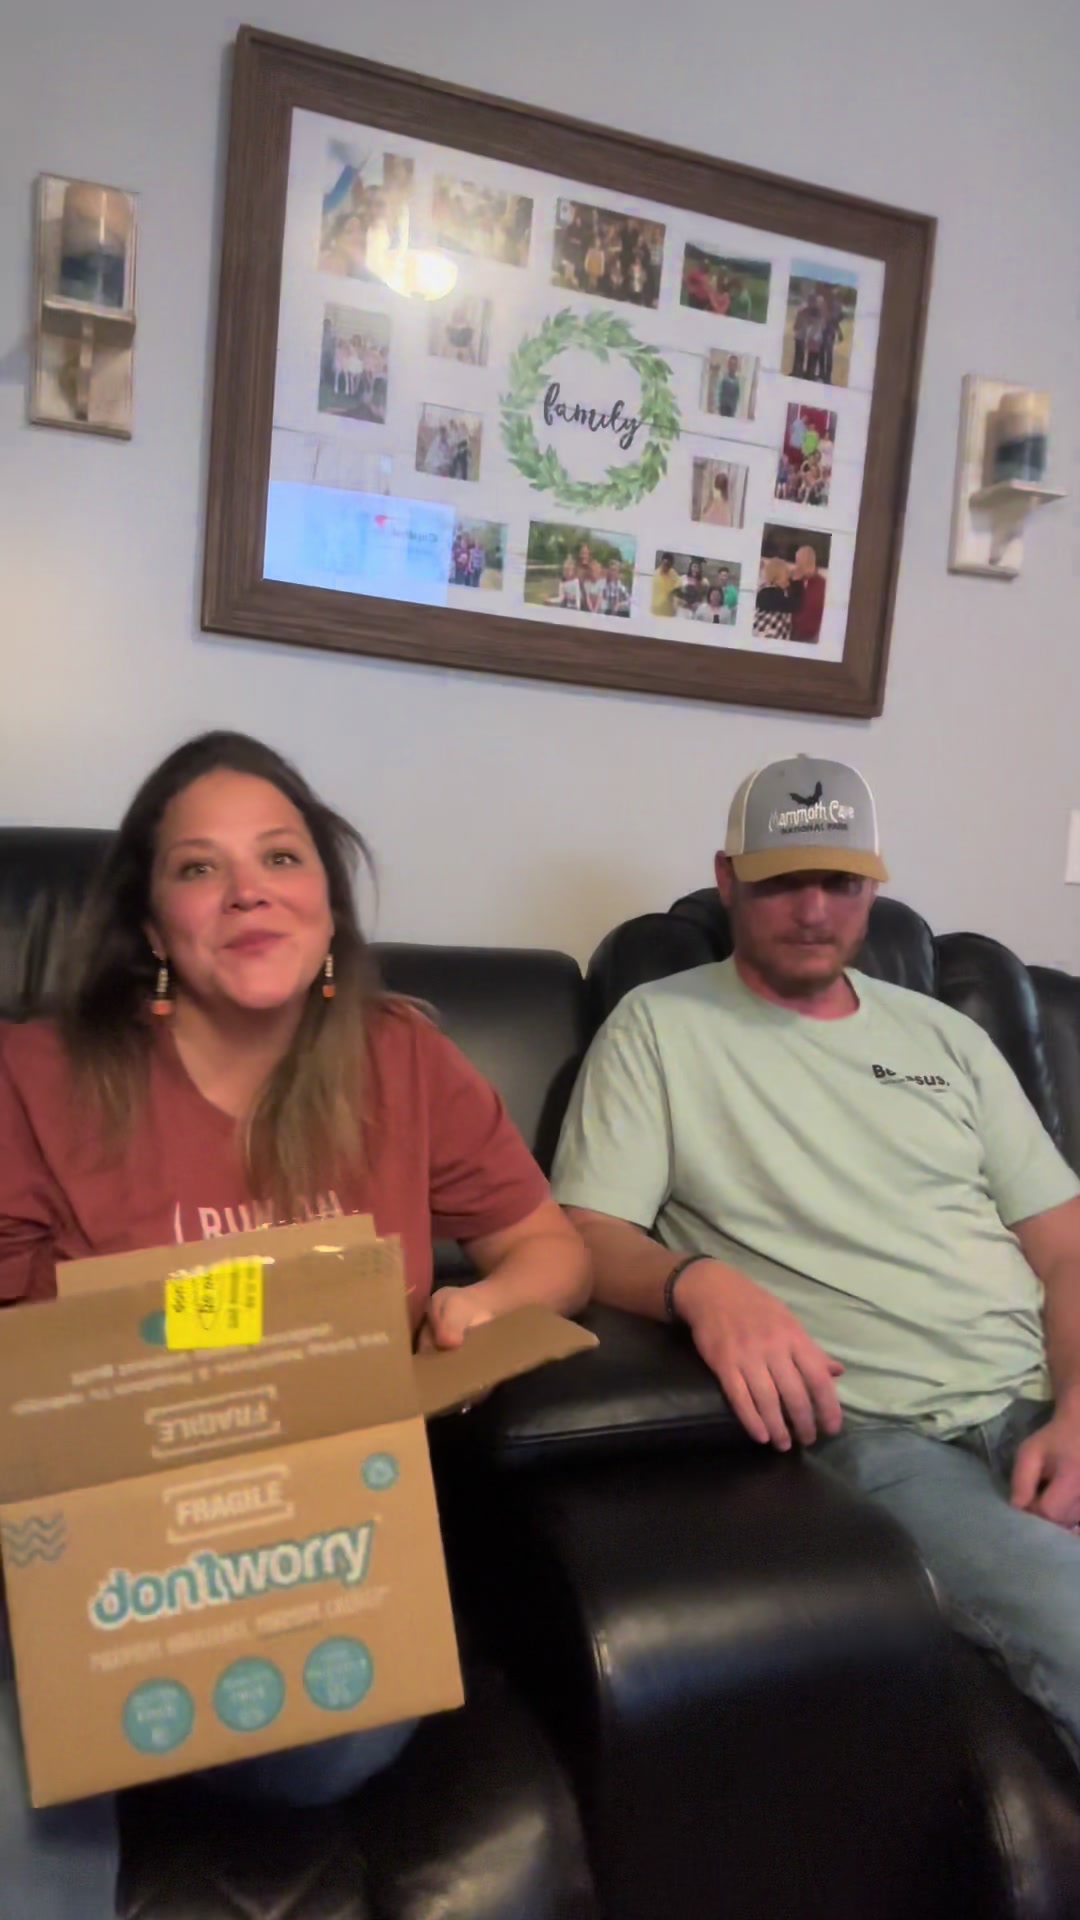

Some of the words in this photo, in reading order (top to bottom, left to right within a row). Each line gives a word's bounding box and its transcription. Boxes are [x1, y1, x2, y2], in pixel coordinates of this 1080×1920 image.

[543, 382, 641, 451] family
[768, 802, 828, 832] Mammoth
[174, 1479, 284, 1527] FRAGILE
